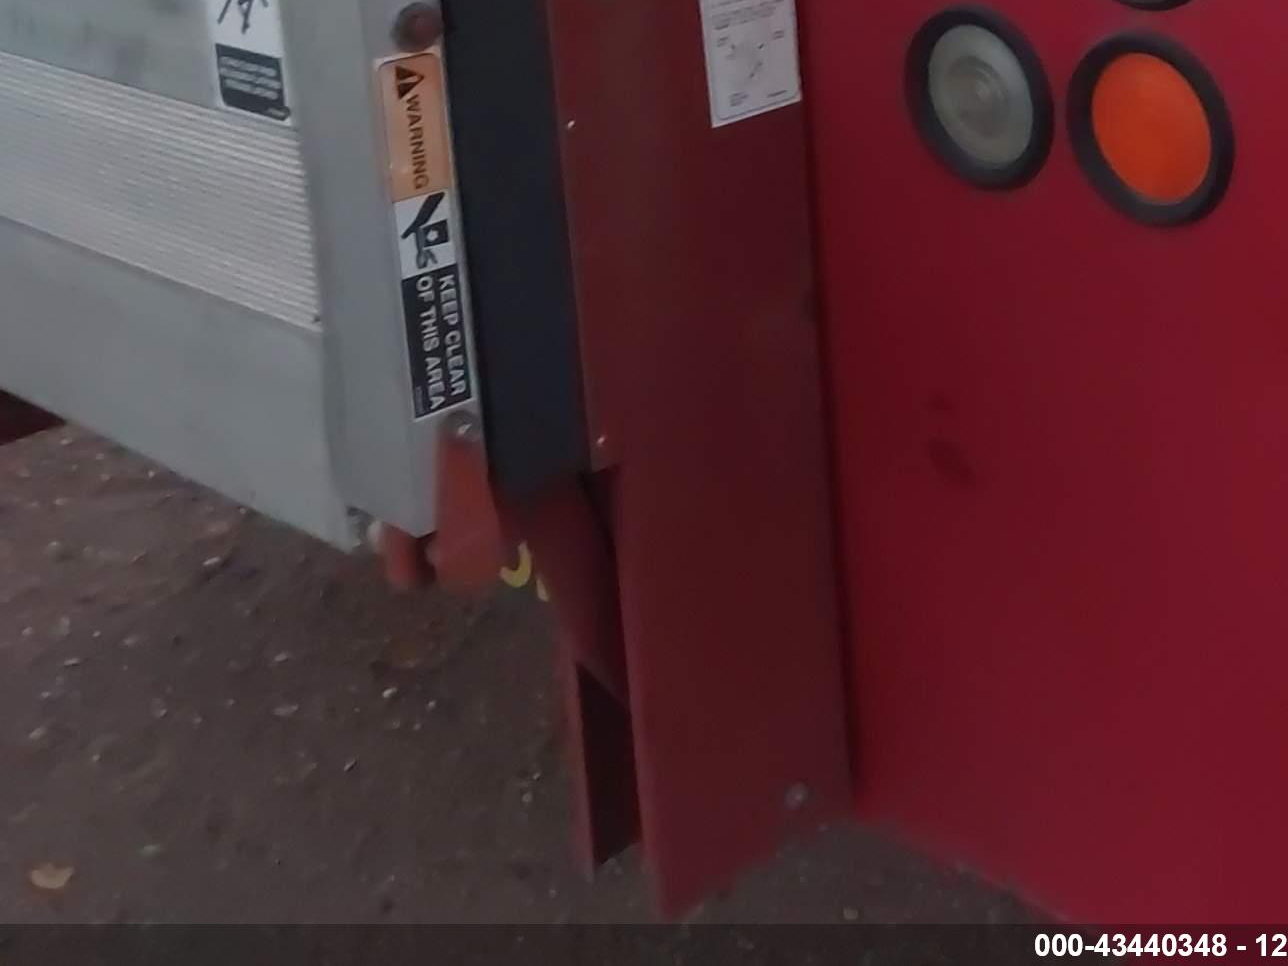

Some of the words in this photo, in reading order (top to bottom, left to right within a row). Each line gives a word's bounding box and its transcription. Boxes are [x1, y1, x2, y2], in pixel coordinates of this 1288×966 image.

[406, 94, 430, 190] WARNING
[416, 275, 435, 302] OF
[439, 274, 460, 325] KEEP
[419, 305, 440, 352] THIS
[425, 357, 446, 410] AREA
[444, 330, 467, 396] CLEAR
